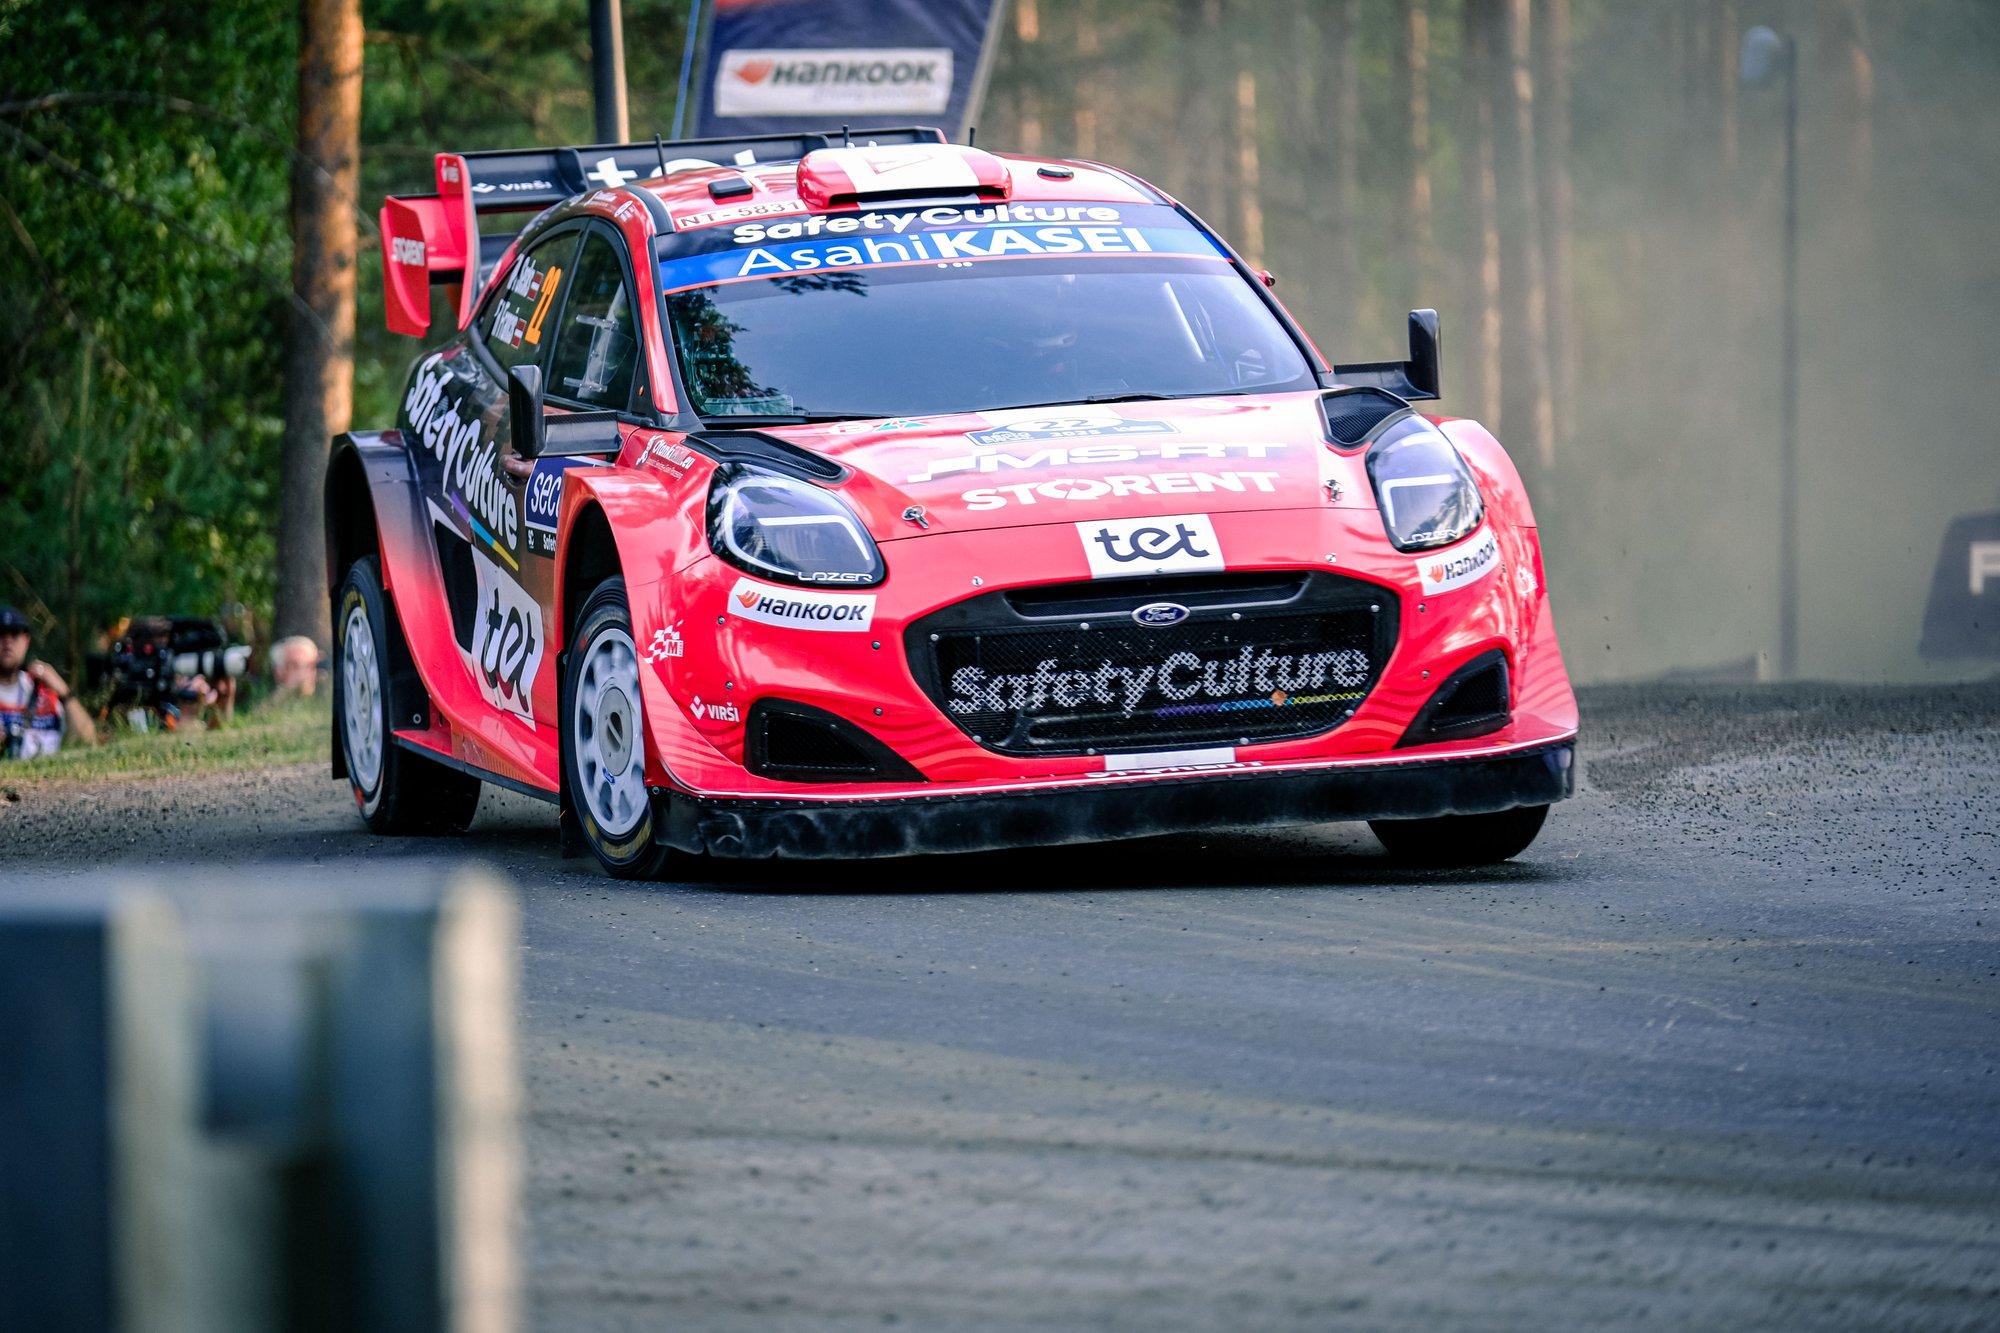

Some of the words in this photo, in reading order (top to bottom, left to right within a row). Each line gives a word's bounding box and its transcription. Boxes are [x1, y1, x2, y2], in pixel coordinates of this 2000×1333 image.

[733, 204, 1121, 244] SafetyCulture
[1036, 419, 1088, 430] 22
[405, 352, 518, 550] SafetyCulture
[961, 472, 1278, 511] STORENT
[1094, 522, 1210, 563] tet
[1145, 607, 1178, 621] Ford
[481, 588, 535, 713] tet
[949, 645, 1369, 718] SafetyCulture
[707, 702, 740, 722] VIRŠI
